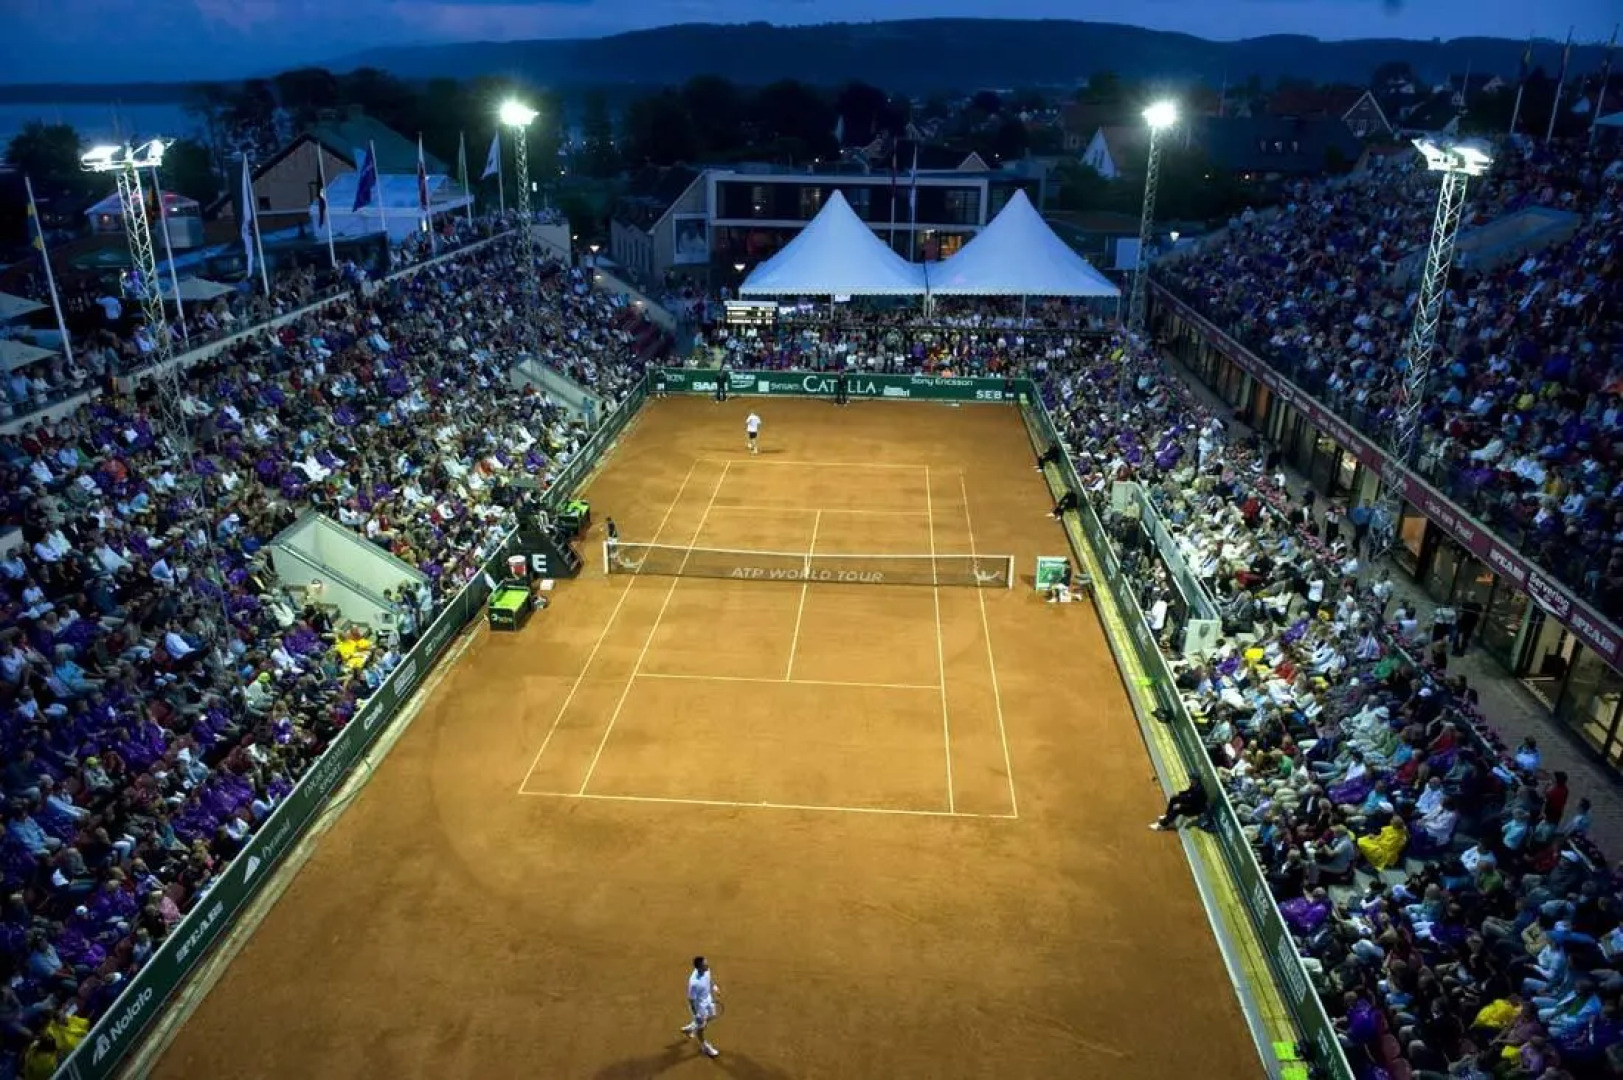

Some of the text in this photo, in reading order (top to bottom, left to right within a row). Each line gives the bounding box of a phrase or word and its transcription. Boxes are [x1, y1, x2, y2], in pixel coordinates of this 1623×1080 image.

[803, 375, 876, 394] CATLLA
[911, 377, 973, 386] Sony Ericsson
[976, 390, 1002, 399] SEB
[532, 554, 547, 572] E
[731, 567, 763, 578] ATP
[837, 570, 883, 582] TOUR
[110, 987, 153, 1042] Nolato
